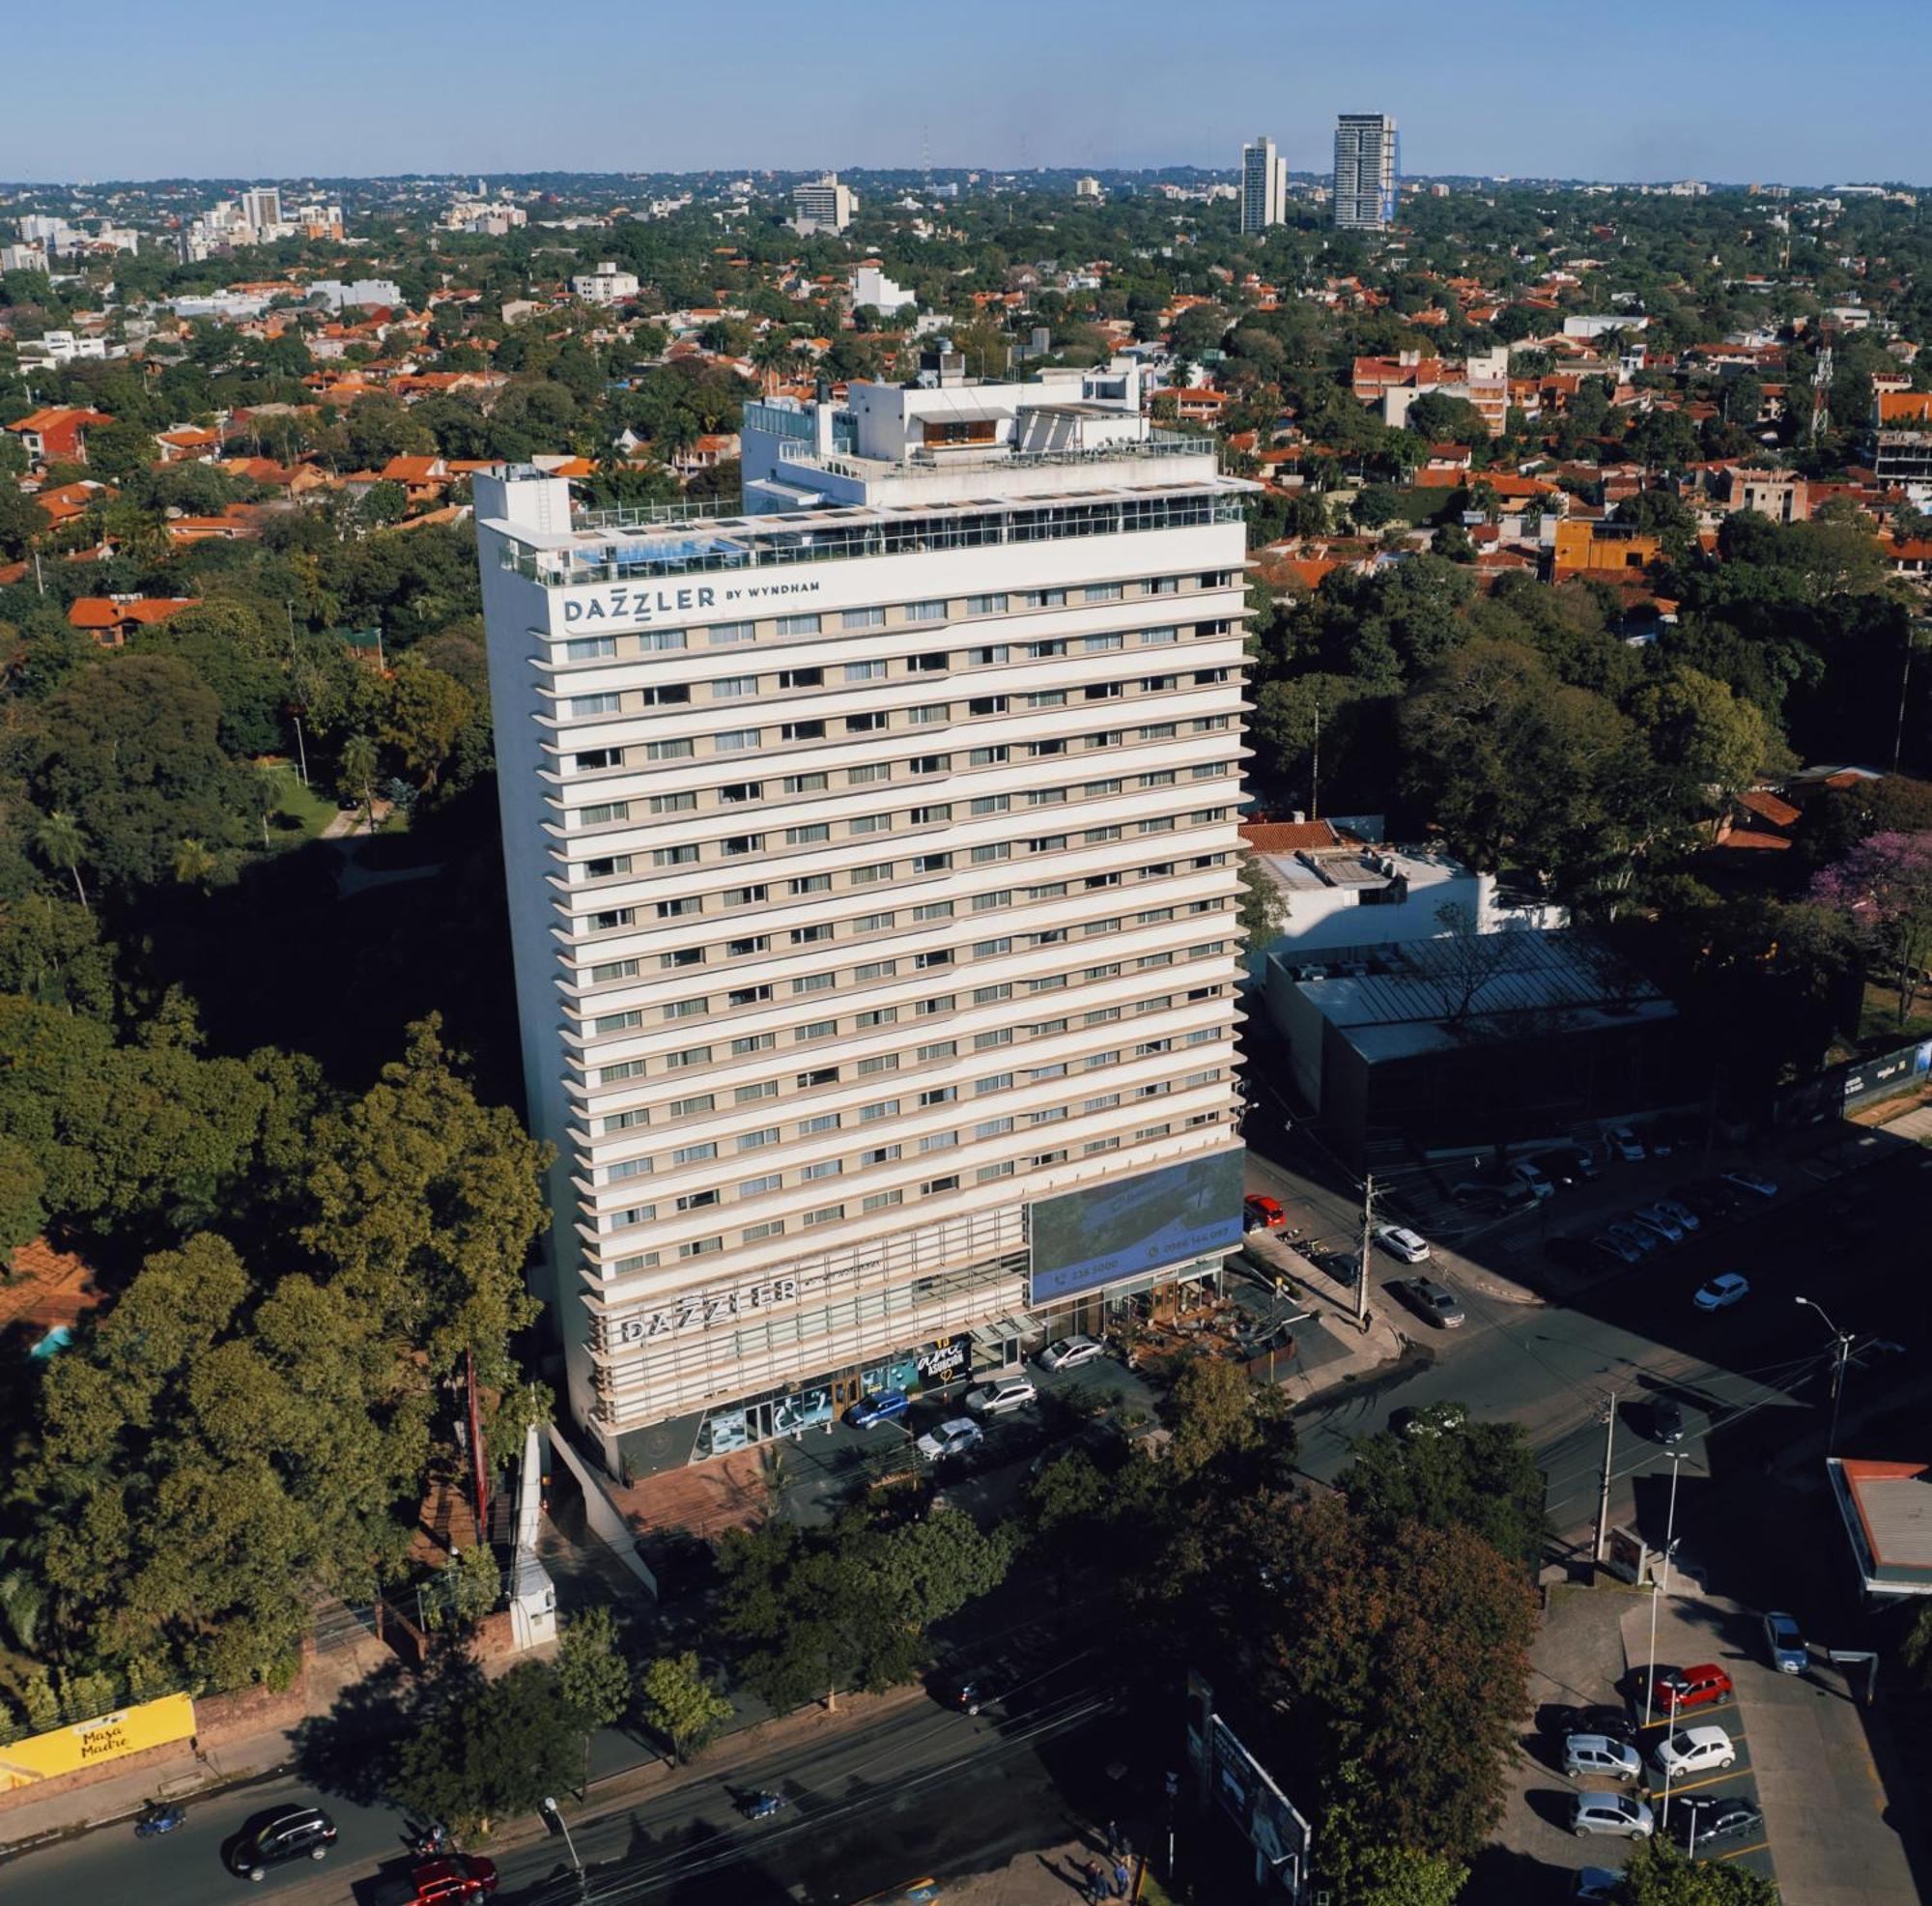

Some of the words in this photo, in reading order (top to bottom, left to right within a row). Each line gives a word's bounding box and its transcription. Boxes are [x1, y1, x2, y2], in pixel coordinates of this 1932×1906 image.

[564, 586, 715, 621] DAZZLER
[725, 589, 742, 601] BY
[749, 581, 820, 598] WYNDHAM
[624, 1279, 798, 1342] DAZZLER
[81, 1738, 128, 1758] Madre
[83, 1727, 124, 1746] Masa
